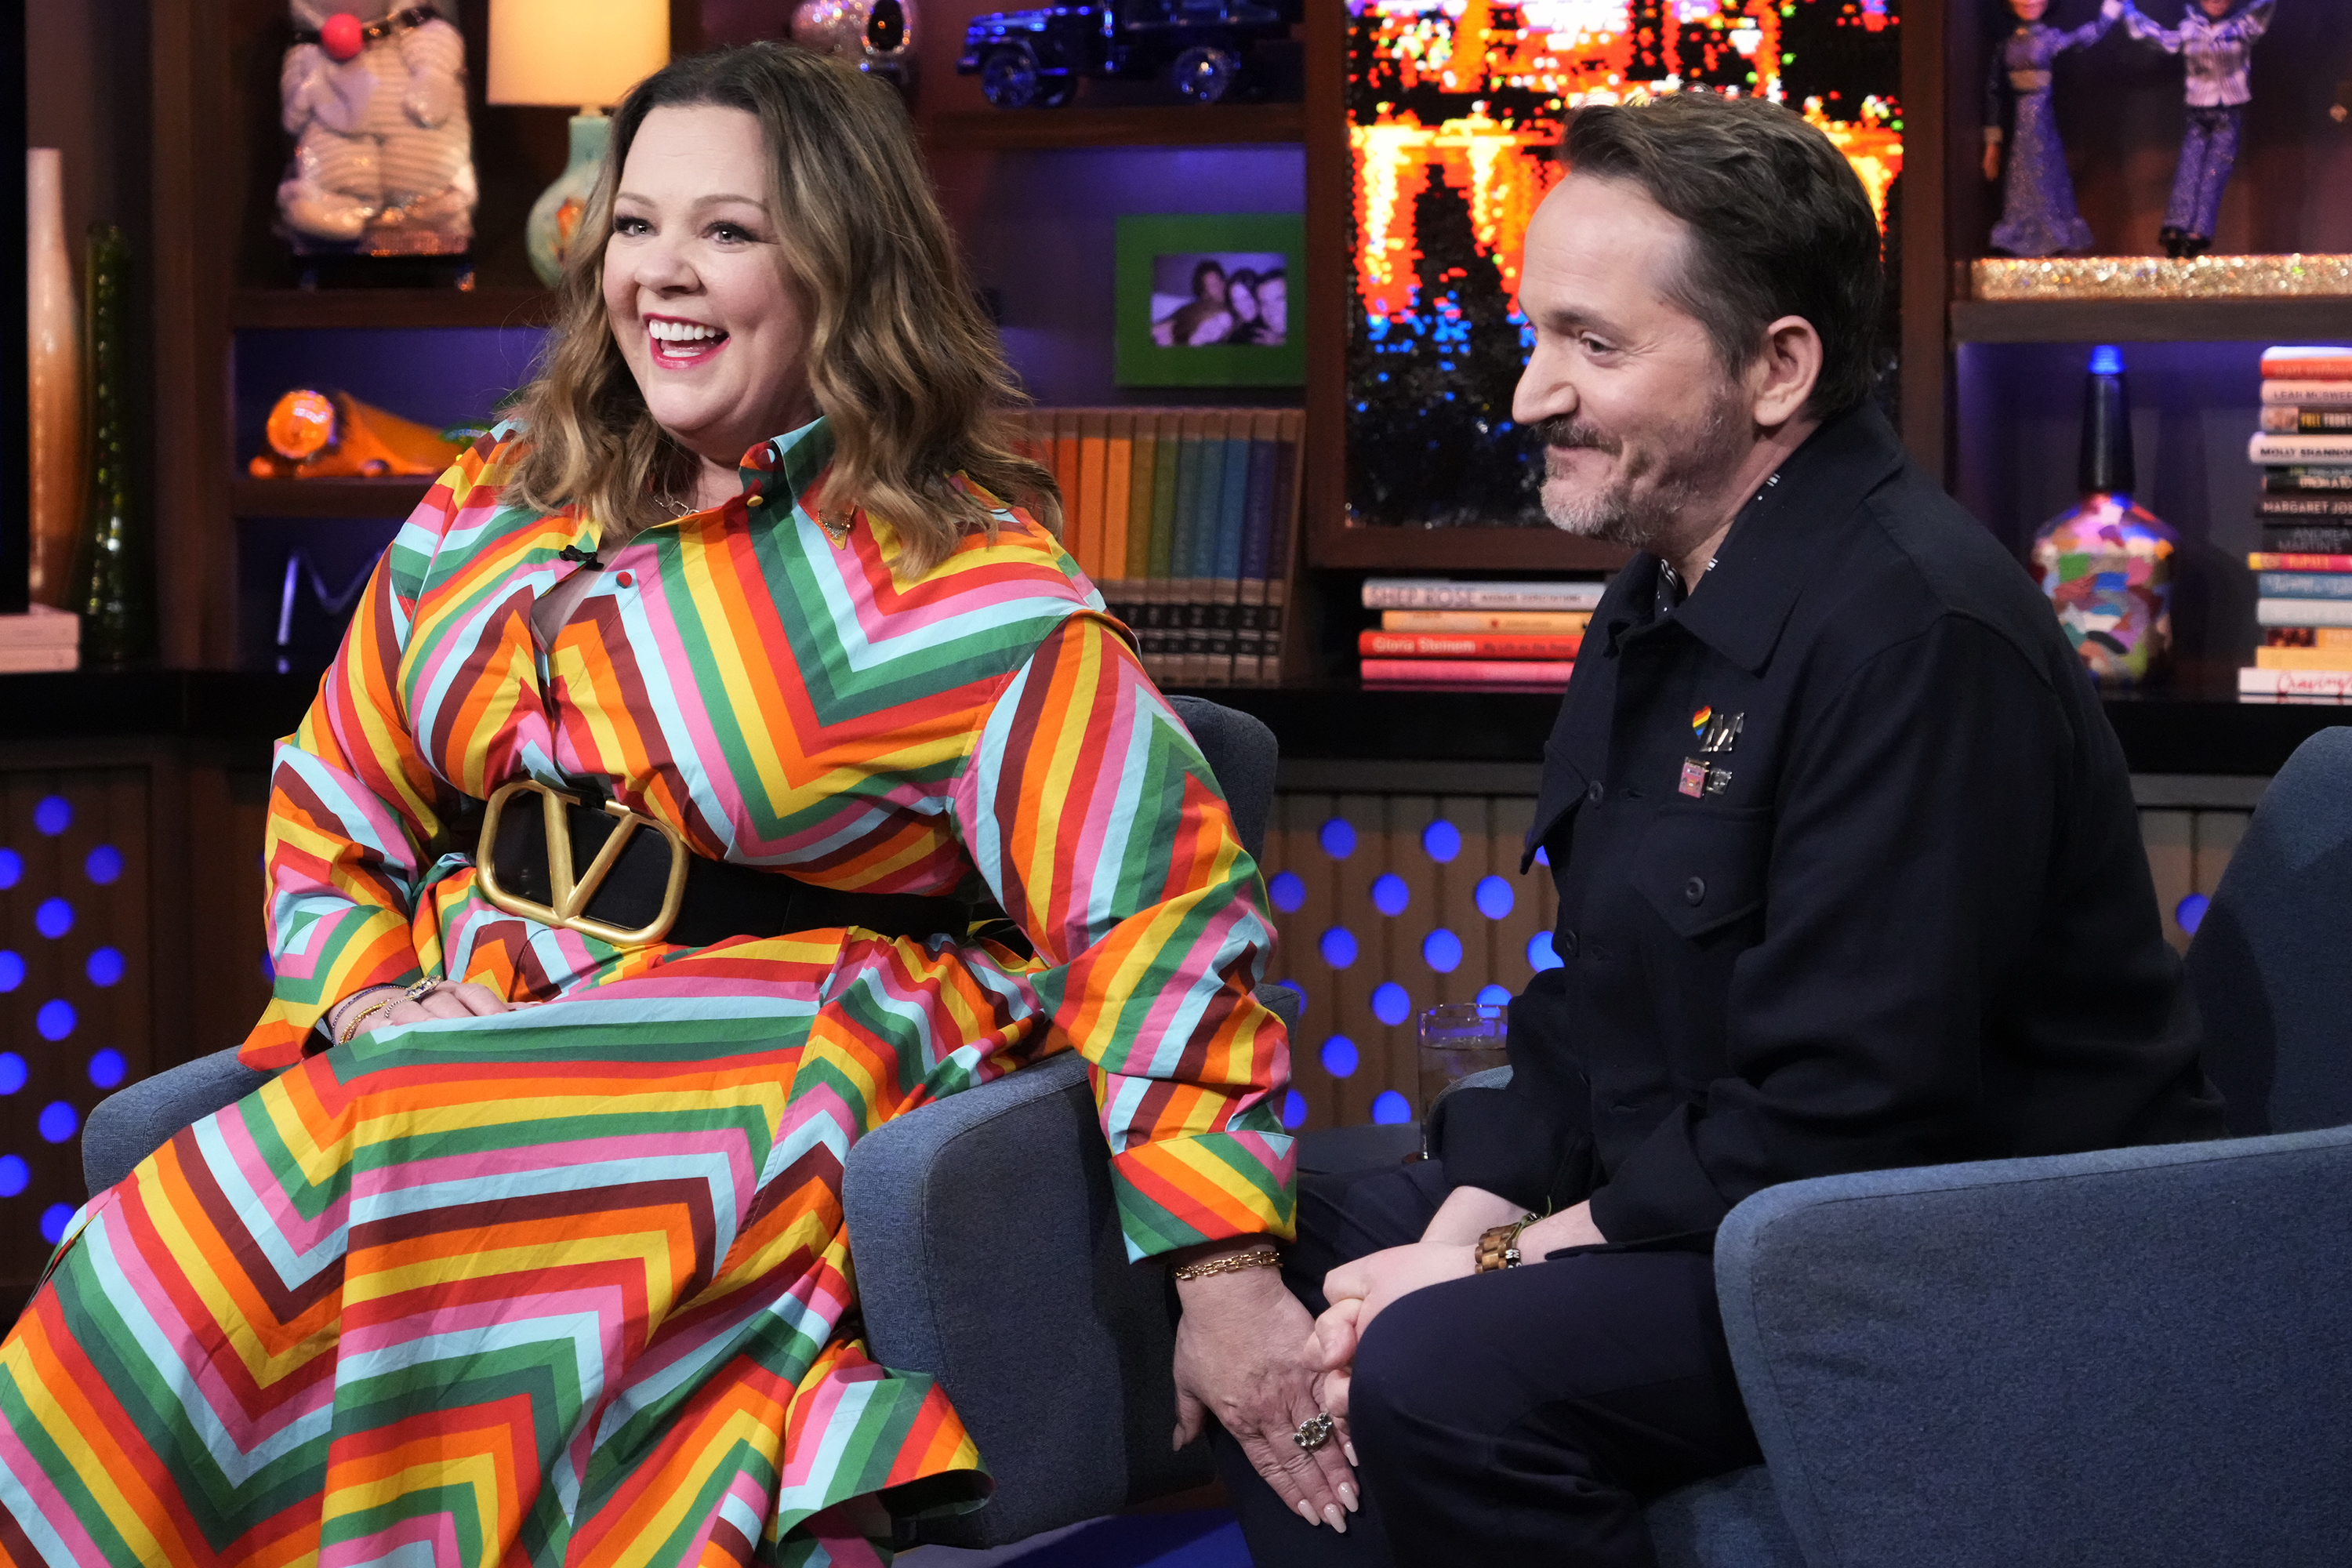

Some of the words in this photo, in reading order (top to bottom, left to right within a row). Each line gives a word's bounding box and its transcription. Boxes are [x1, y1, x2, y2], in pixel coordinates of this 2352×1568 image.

[2274, 391, 2303, 401] LEAH
[2259, 448, 2295, 456] MOLLY
[2263, 500, 2328, 514] MARGARET
[1372, 637, 1415, 652] Gloria
[1417, 637, 1476, 653] Steinem
